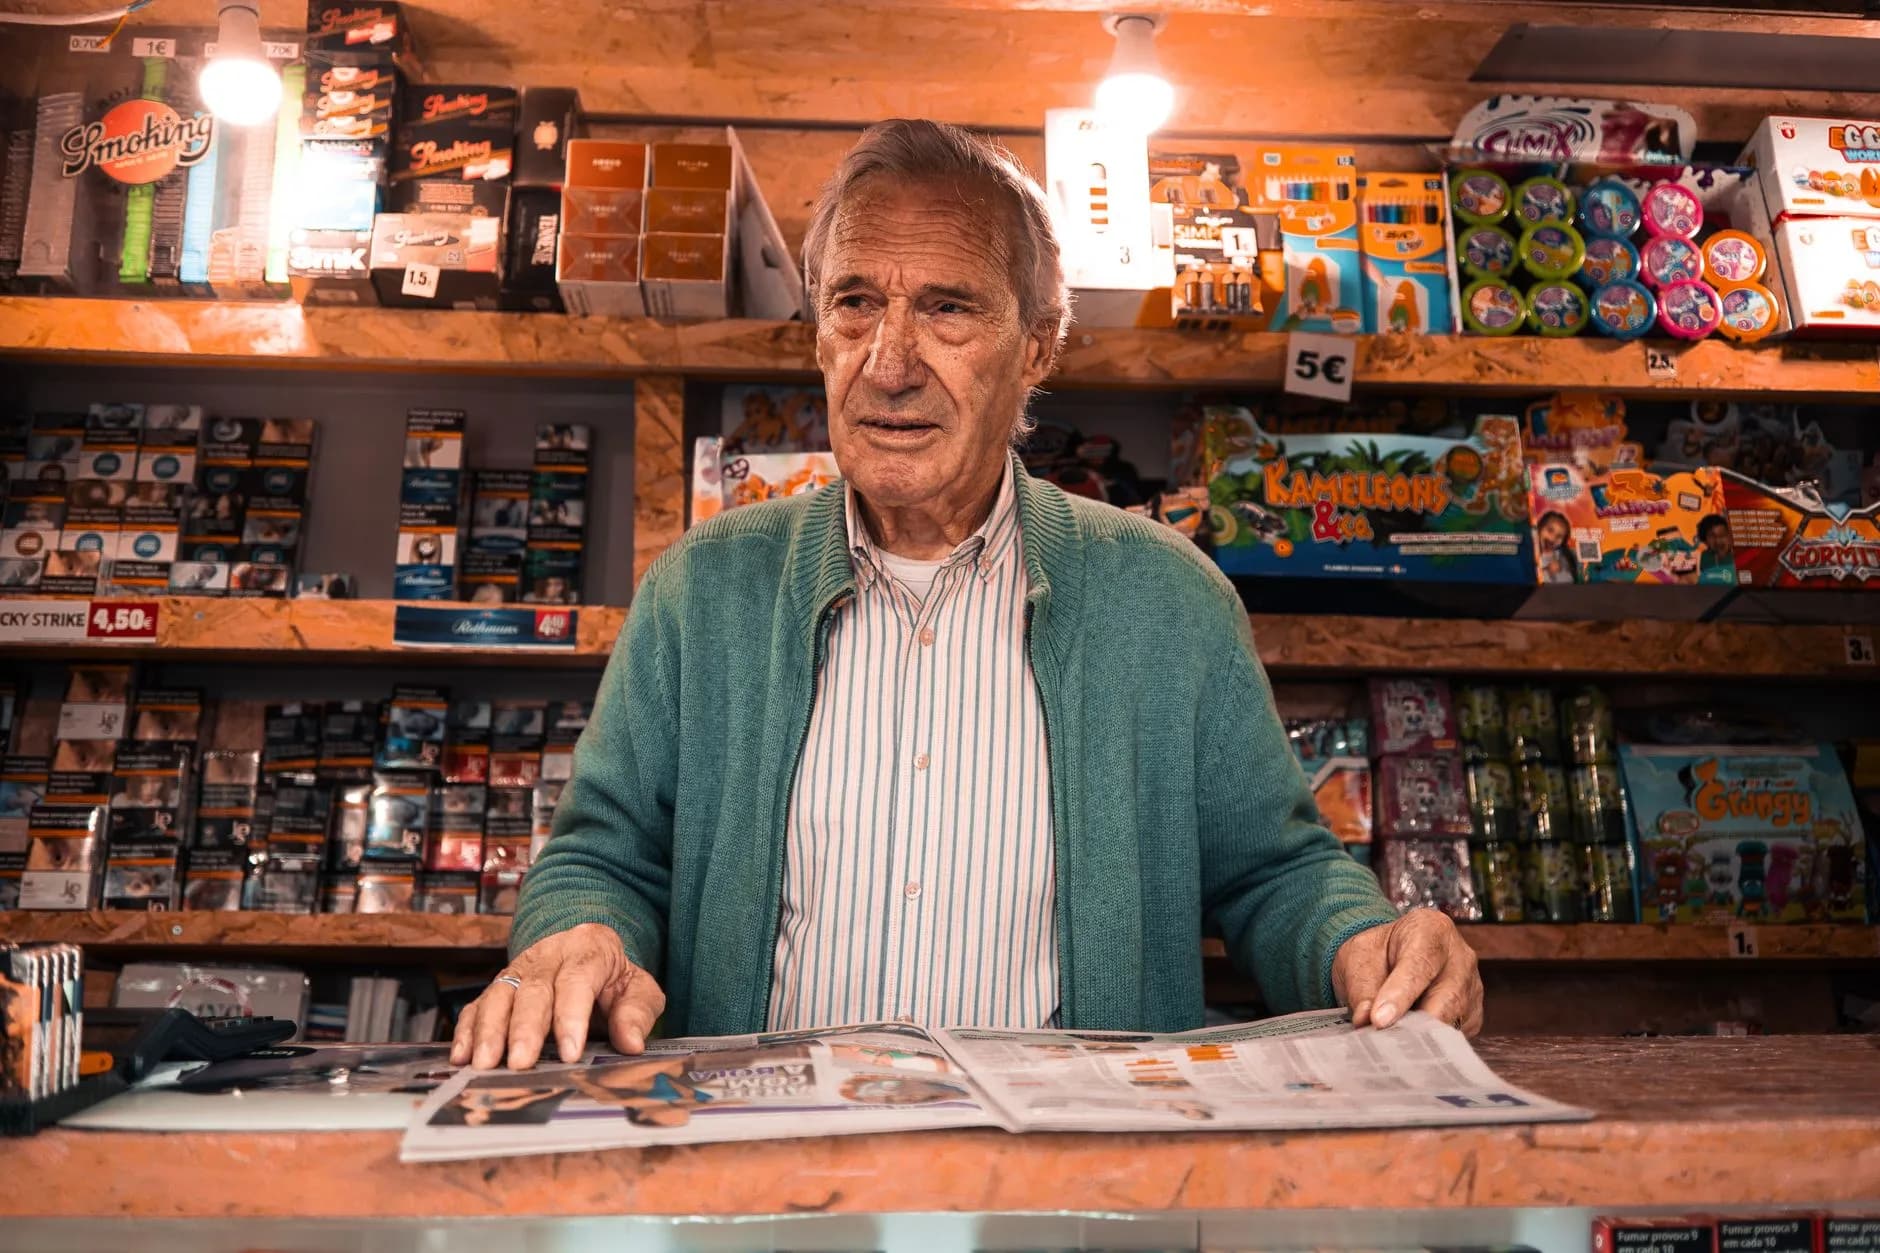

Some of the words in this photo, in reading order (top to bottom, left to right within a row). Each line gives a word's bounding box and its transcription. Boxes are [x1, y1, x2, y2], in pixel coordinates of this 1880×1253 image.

[146, 40, 167, 55] 1€
[61, 111, 214, 178] Smoking
[1829, 124, 1880, 149] EGG
[1295, 350, 1346, 384] 5€
[1265, 456, 1450, 513] KAMELEONS
[31, 612, 86, 627] STRIKE
[93, 607, 153, 633] 4,50€
[1722, 1223, 1753, 1235] Fumar
[1754, 1223, 1791, 1238] provoca
[1791, 1222, 1799, 1233] 9
[1828, 1221, 1860, 1233] Fumar
[1618, 1230, 1650, 1241] Fumar
[1651, 1231, 1690, 1245] provoca
[1690, 1229, 1698, 1241] 9
[1722, 1240, 1739, 1249] em
[1740, 1237, 1763, 1248] cada
[1765, 1237, 1777, 1248] 10
[1829, 1237, 1846, 1246] em
[1636, 1244, 1660, 1253] cada
